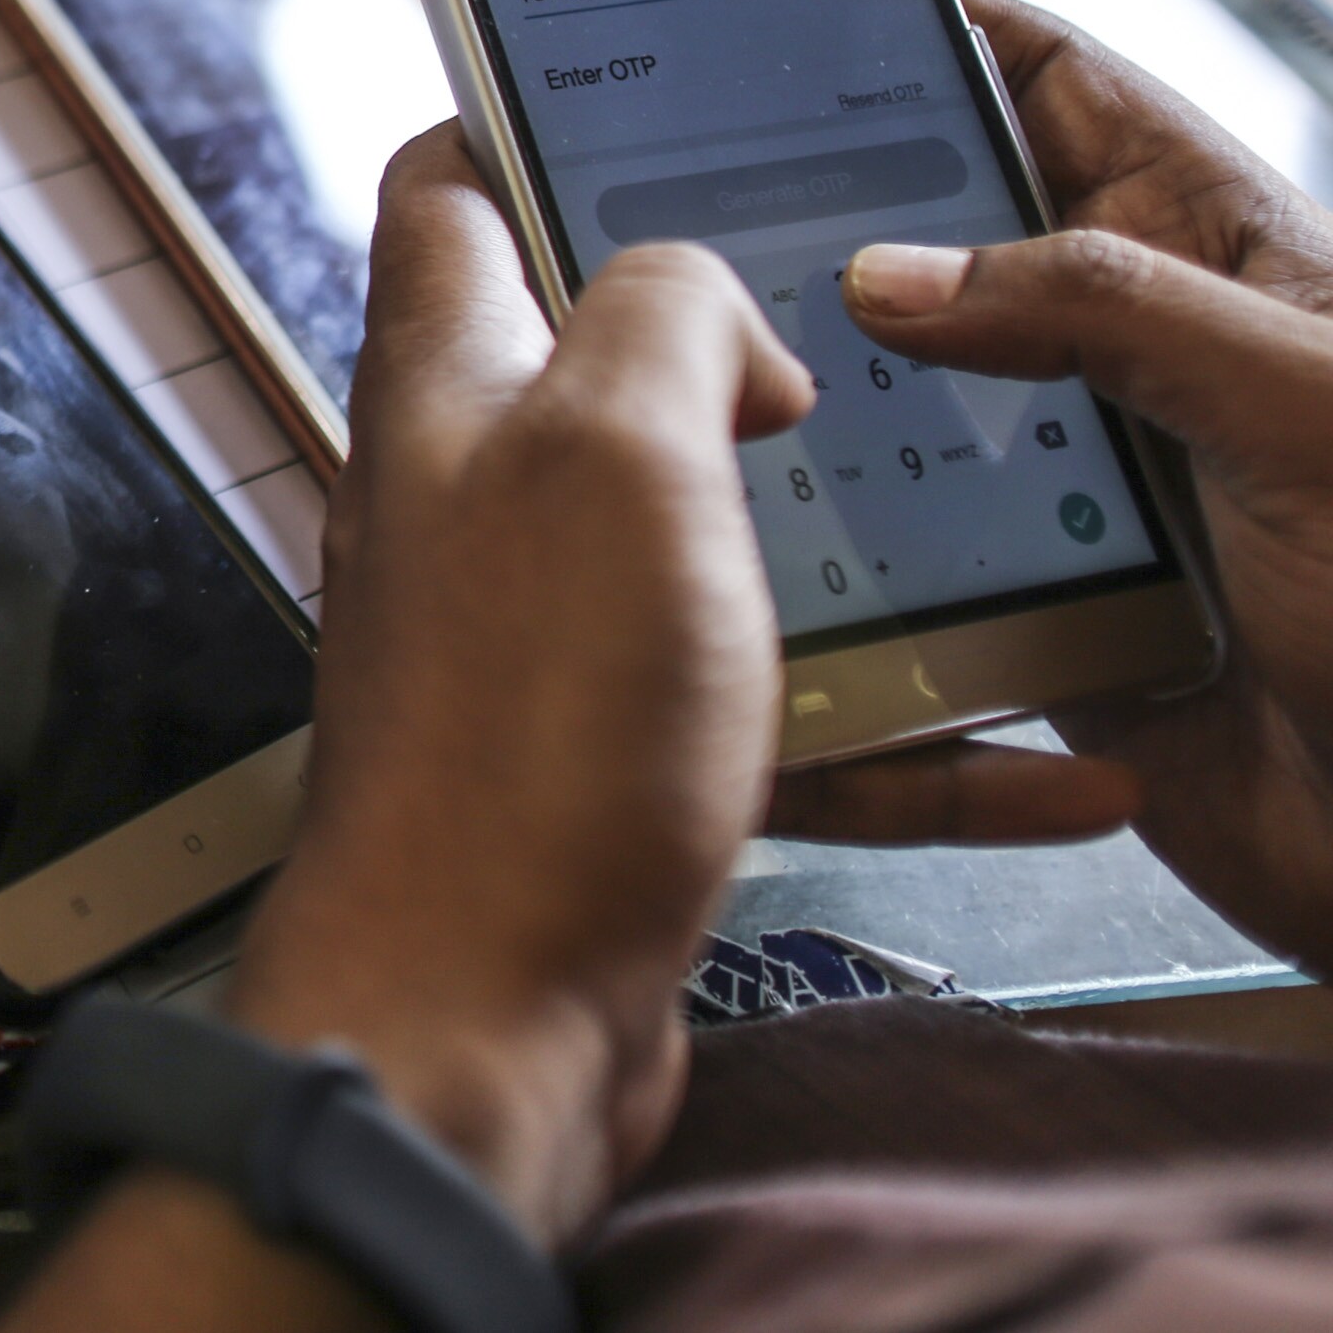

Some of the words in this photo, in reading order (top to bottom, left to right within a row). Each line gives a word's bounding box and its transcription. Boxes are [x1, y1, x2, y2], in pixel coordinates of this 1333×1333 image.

[544, 66, 603, 90] Enter
[608, 55, 656, 81] OTP
[837, 89, 891, 110] Resend
[894, 82, 925, 100] OTP
[716, 181, 806, 212] Generate
[809, 172, 852, 197] OTP
[772, 288, 799, 304] ABC
[869, 358, 892, 391] 6
[789, 468, 814, 502] 8
[899, 447, 924, 480] 9
[938, 444, 980, 463] WXYZ
[822, 560, 848, 595] 0
